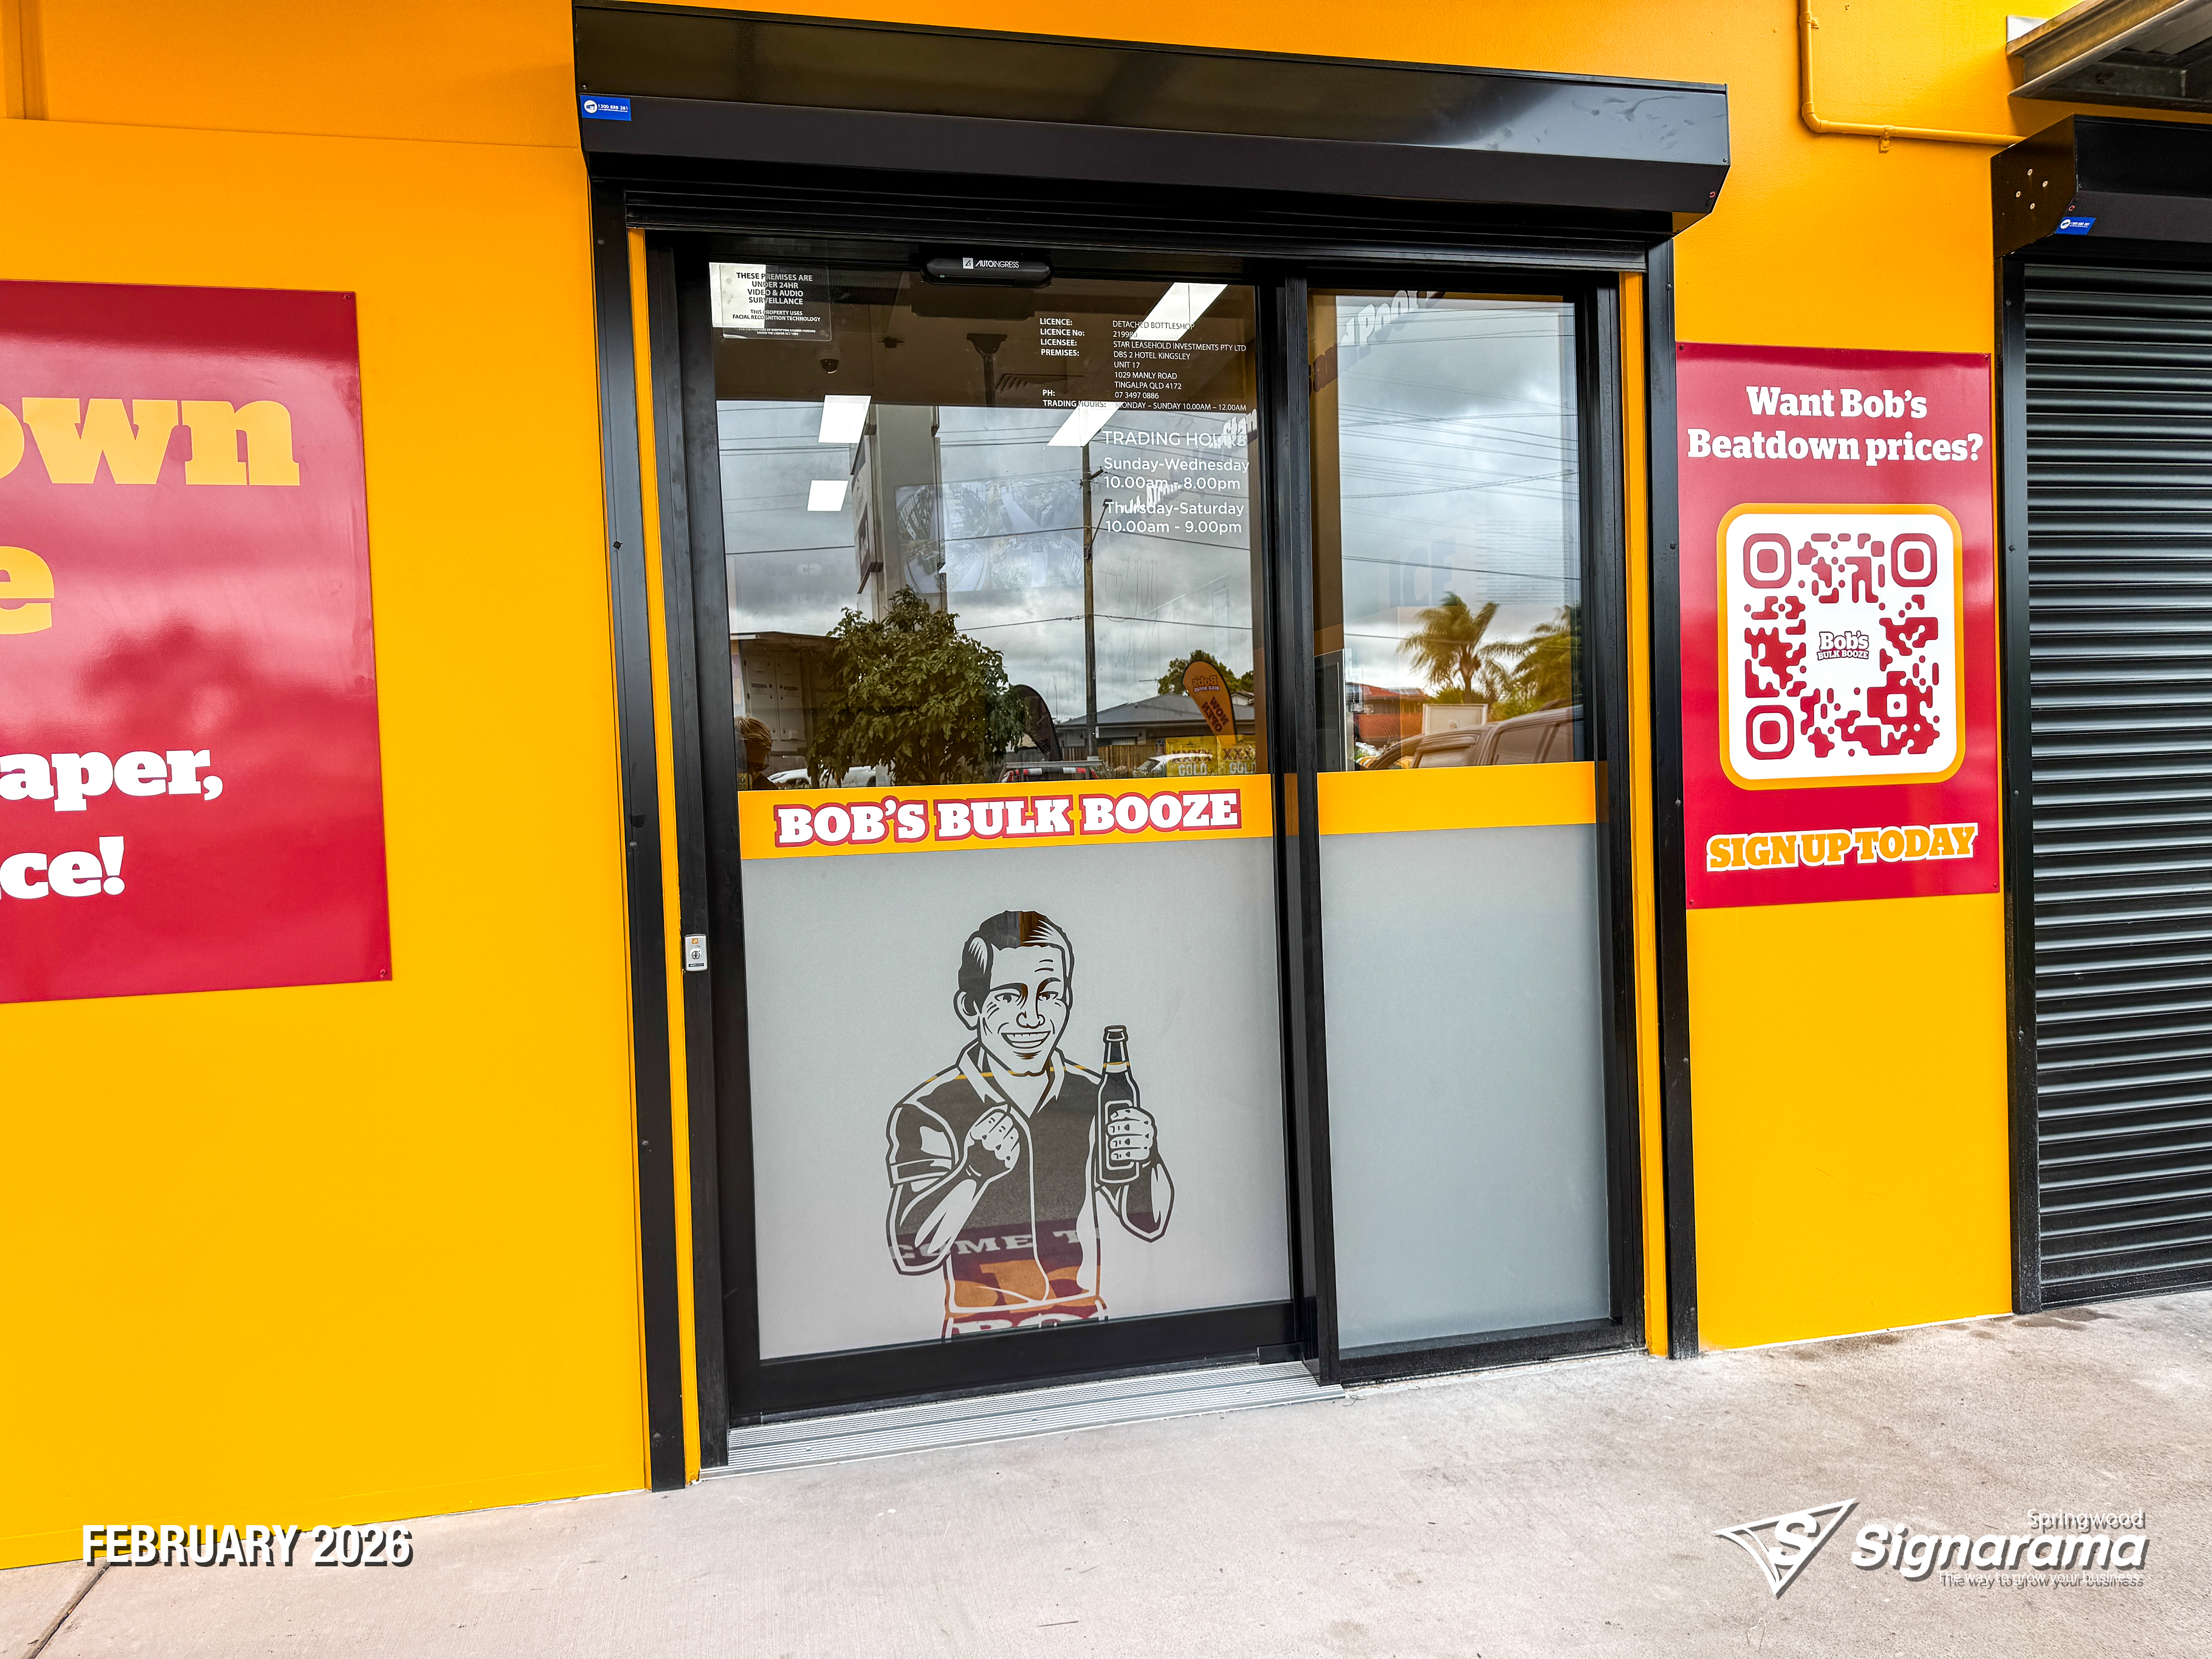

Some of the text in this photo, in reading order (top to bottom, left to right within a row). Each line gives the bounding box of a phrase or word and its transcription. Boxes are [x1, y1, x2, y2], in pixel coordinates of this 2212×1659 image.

[975, 260, 1019, 268] AUTOINGRESS
[748, 297, 803, 305] SURVEILLANCE
[1151, 322, 1195, 330] BOTTLESHOP
[1173, 343, 1219, 351] INVESTMENTS
[1746, 386, 1927, 419] Want Bob's
[0, 397, 300, 487] wn
[1102, 431, 1247, 447] TRADING HOURS
[1687, 428, 1984, 466] Beatdown prices?
[1104, 457, 1250, 473] Sunday-Wednesday
[1104, 476, 1168, 489] 10.00am
[1183, 476, 1240, 492] 8.00pm
[1105, 501, 1244, 517] Thursday-Saturday
[1105, 520, 1170, 533] 10.00am
[1185, 521, 1242, 535] 9.00pm
[1819, 630, 1869, 651] Bob's
[1817, 650, 1869, 661] BULK BOOZE
[1178, 763, 1207, 776] GOLD
[775, 791, 1240, 847] BOB'S BULK BOOZE
[1708, 825, 1976, 870] SIGN UP TODAY
